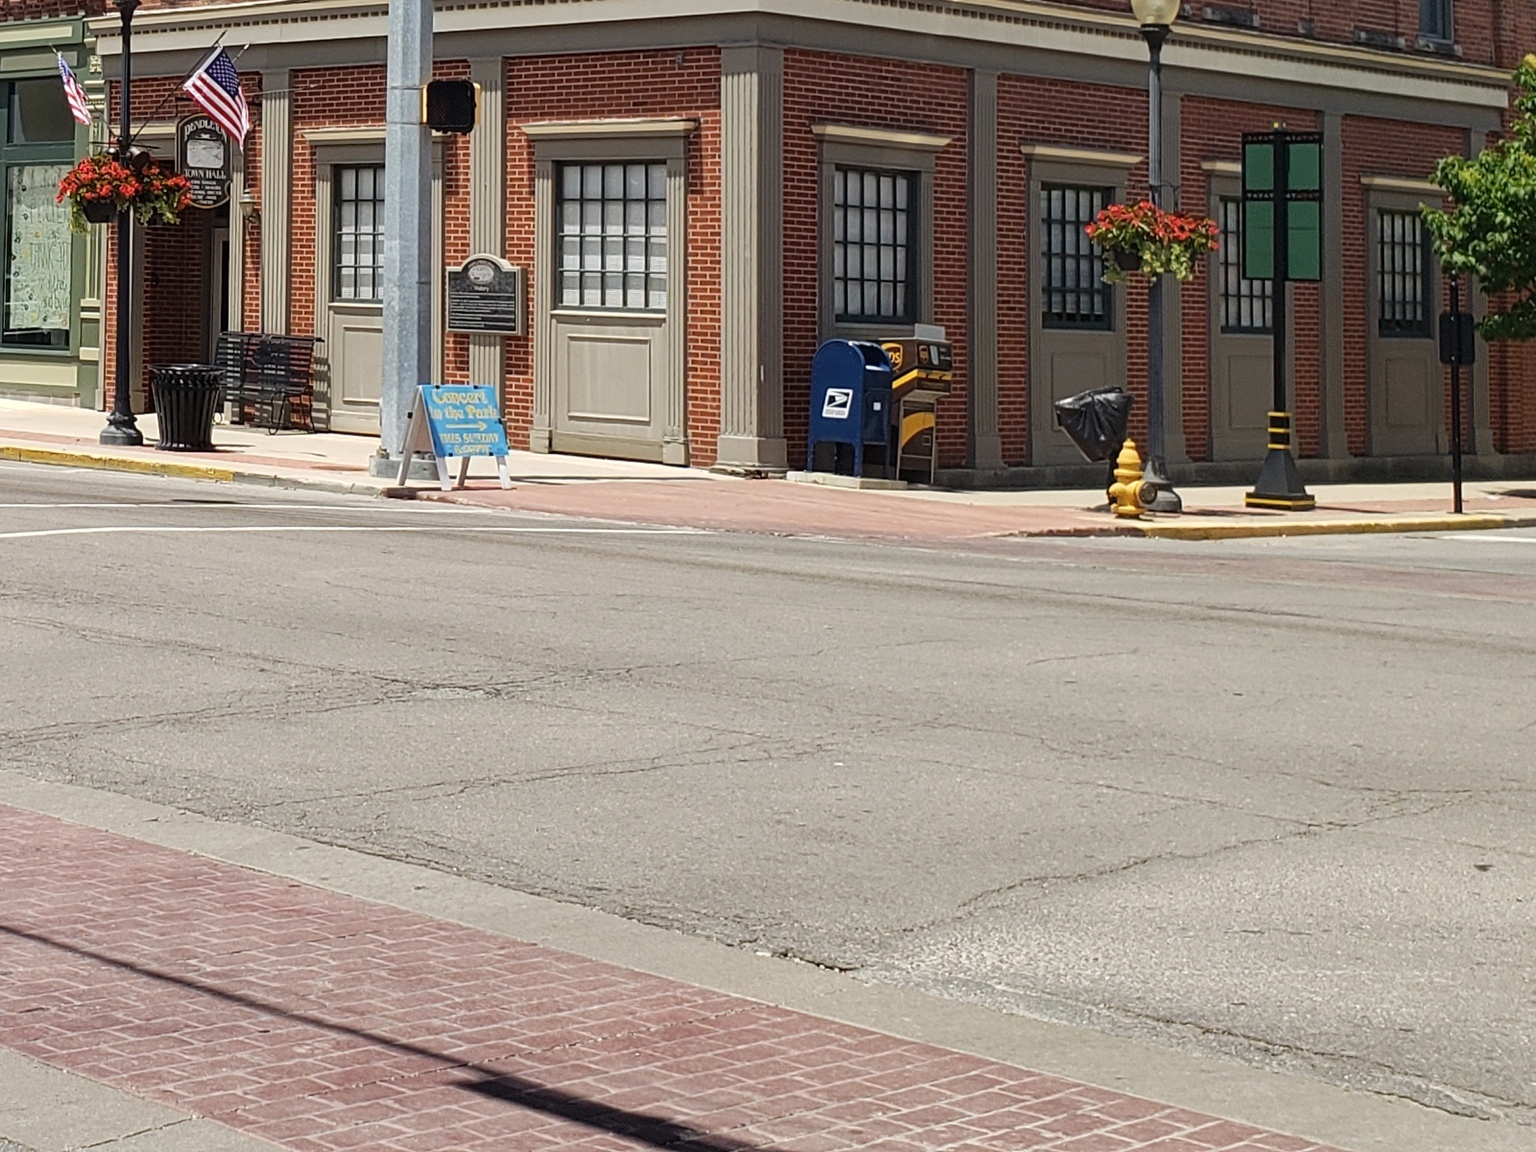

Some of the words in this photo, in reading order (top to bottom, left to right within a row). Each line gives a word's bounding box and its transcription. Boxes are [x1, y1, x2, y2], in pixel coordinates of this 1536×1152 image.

[184, 169, 204, 178] TOWN
[206, 169, 227, 179] HALL
[431, 389, 488, 405] Concert
[466, 404, 500, 419] Park
